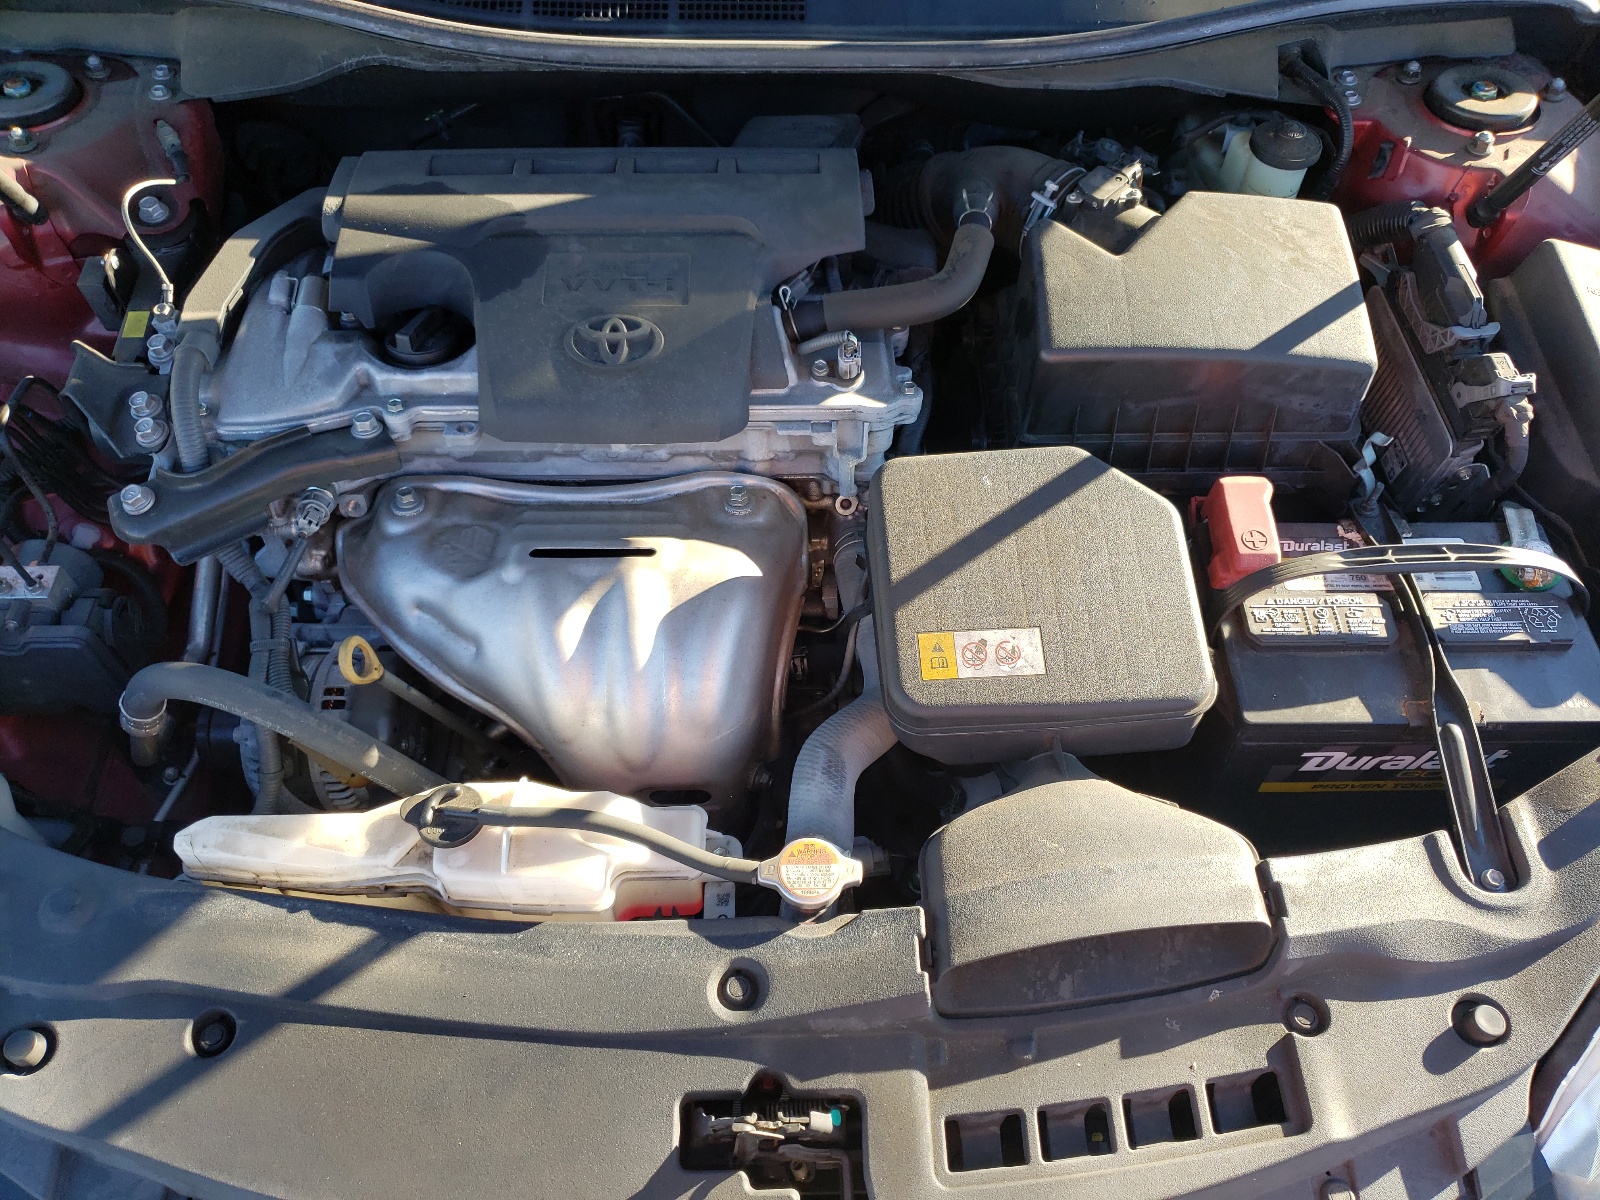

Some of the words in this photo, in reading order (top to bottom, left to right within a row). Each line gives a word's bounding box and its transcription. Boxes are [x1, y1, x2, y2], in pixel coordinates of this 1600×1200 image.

[1279, 539, 1350, 551] Duralast
[1276, 597, 1317, 605] DANGER
[1326, 596, 1363, 605] POISON
[1298, 749, 1510, 772] Duralat
[1311, 782, 1387, 790] PROVEN
[1393, 781, 1445, 790] TOUG
